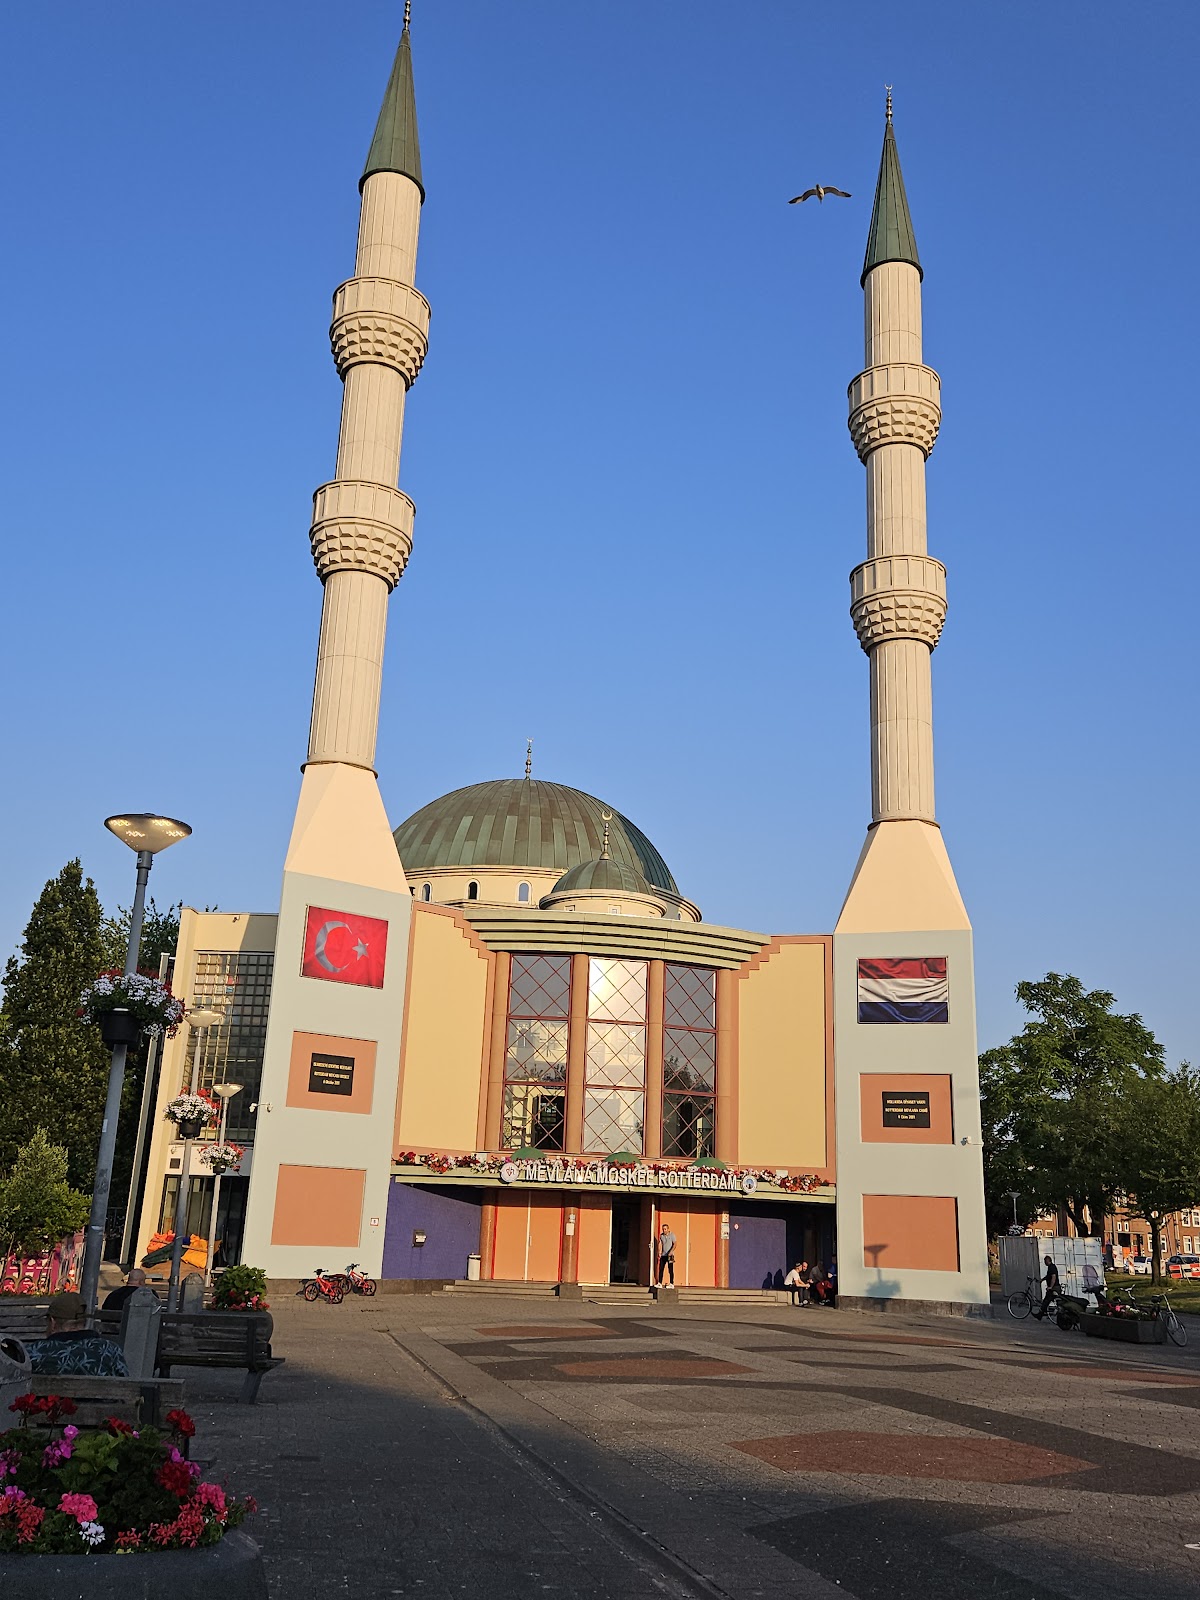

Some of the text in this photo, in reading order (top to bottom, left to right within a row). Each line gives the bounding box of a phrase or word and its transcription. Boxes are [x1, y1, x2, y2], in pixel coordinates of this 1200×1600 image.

[525, 1164, 737, 1190] MEVLANA MOSKEE ROTTERDAM
